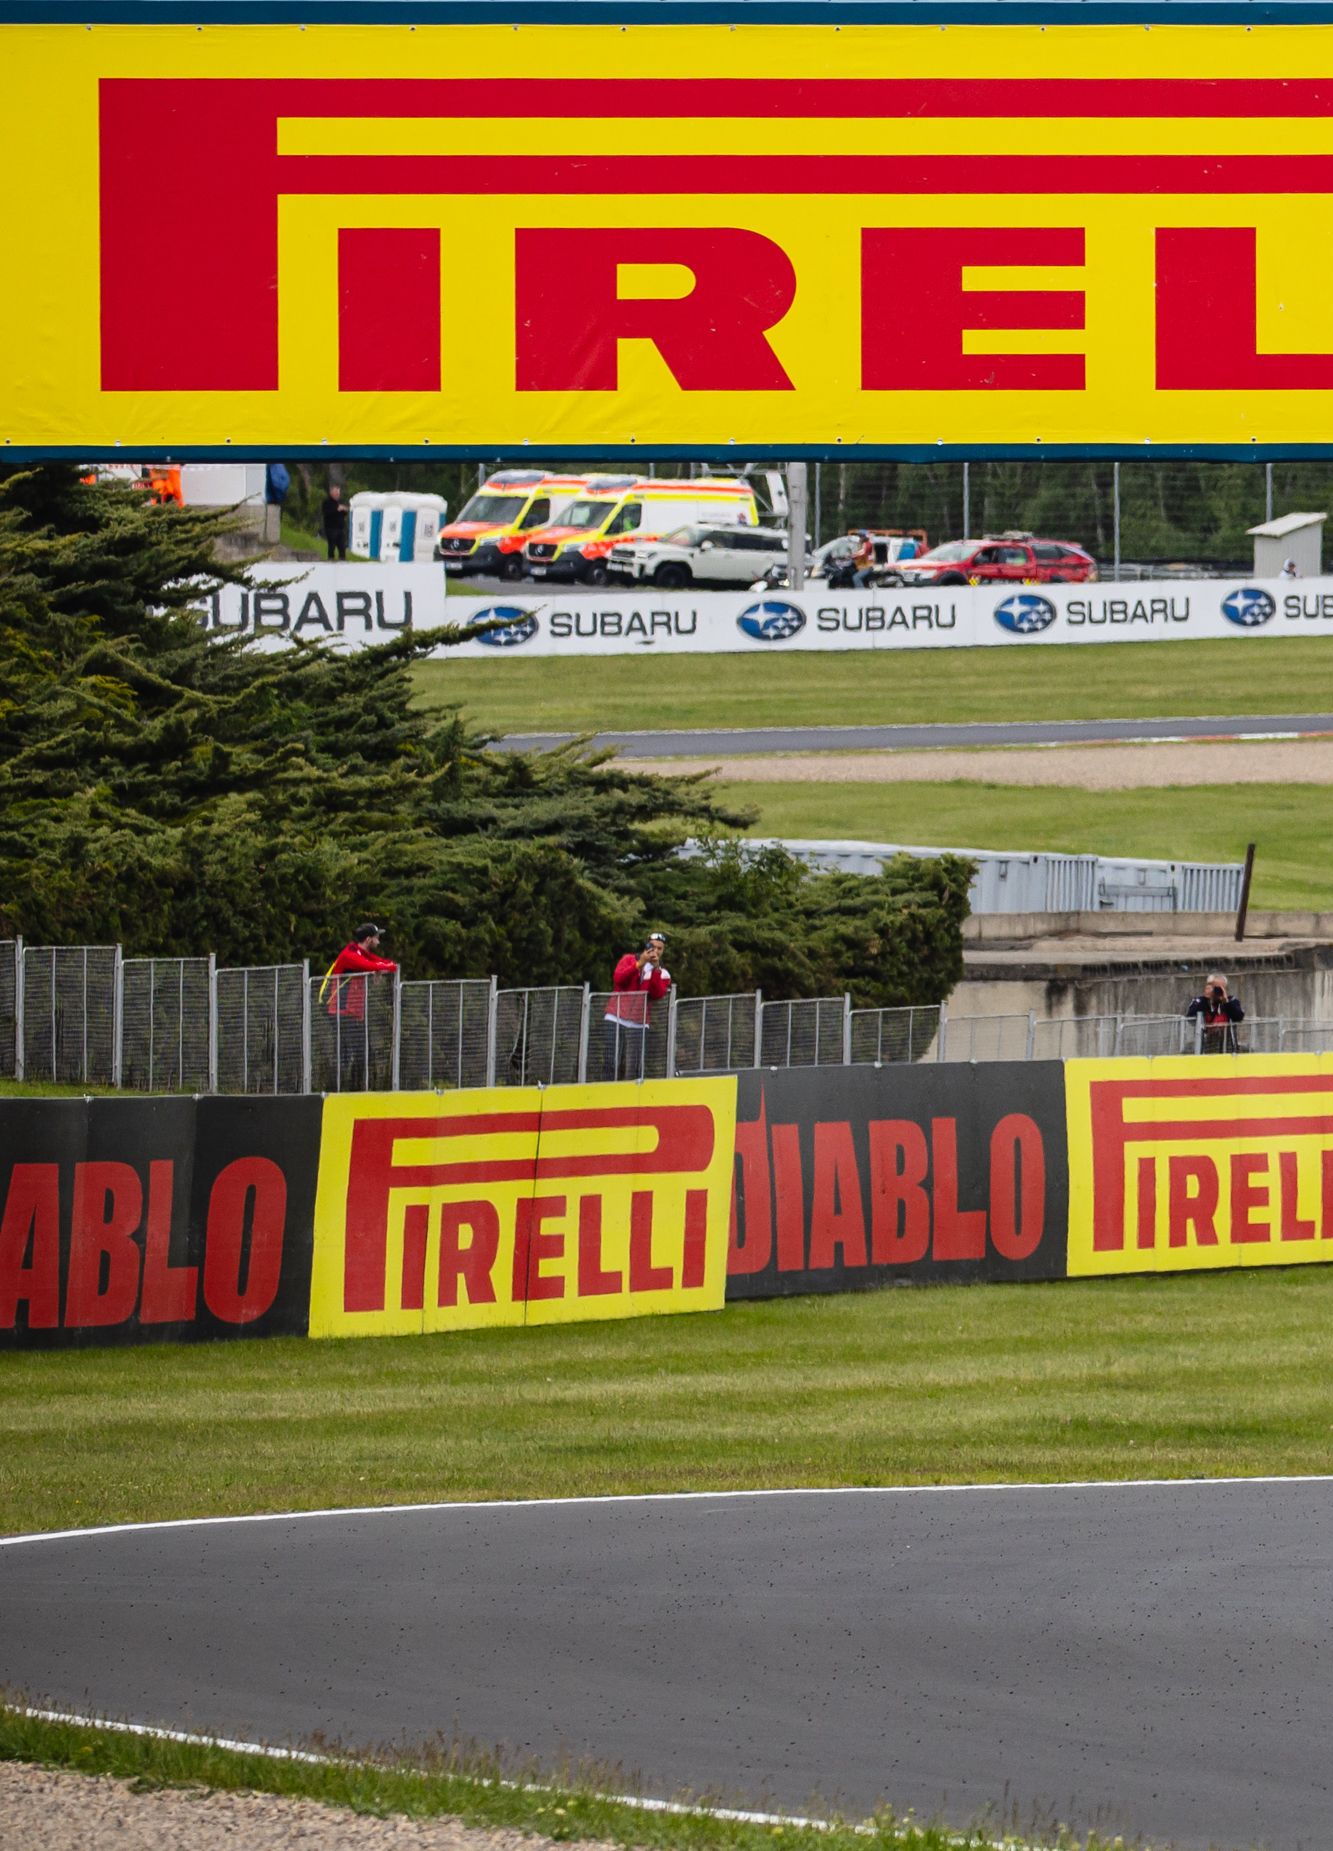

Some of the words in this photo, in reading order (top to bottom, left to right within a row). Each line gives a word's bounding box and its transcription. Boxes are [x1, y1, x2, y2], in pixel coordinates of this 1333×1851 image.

[550, 611, 698, 638] SUBARU
[818, 605, 957, 632] SUBARU
[1067, 598, 1191, 626] SUBARU
[345, 1105, 716, 1314] PIRELLI
